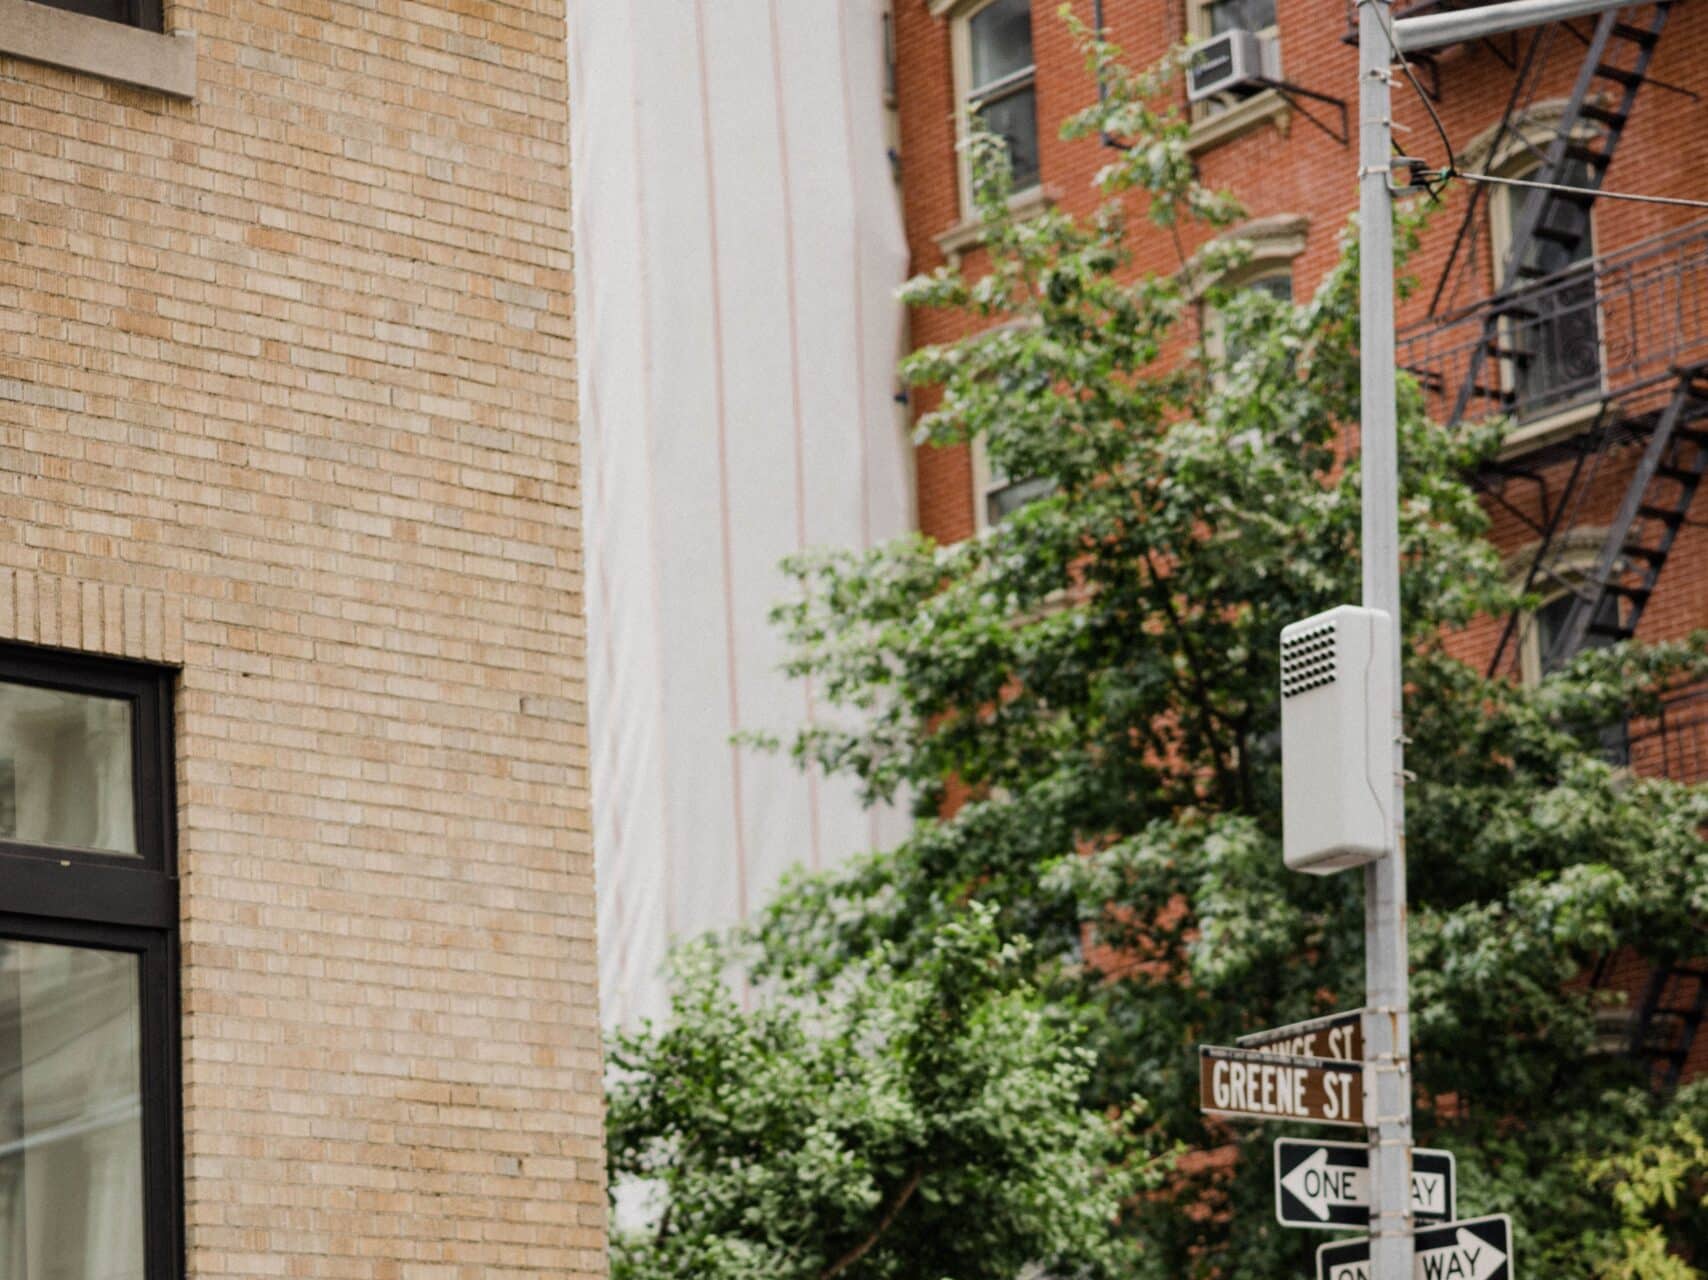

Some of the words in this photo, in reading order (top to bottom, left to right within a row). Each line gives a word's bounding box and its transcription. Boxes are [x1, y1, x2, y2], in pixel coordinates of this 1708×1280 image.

[1328, 1025, 1355, 1061] ST
[1213, 1060, 1310, 1117] GREENE
[1322, 1071, 1353, 1121] ST
[1304, 1169, 1357, 1200] ONE
[1412, 1177, 1437, 1206] AY
